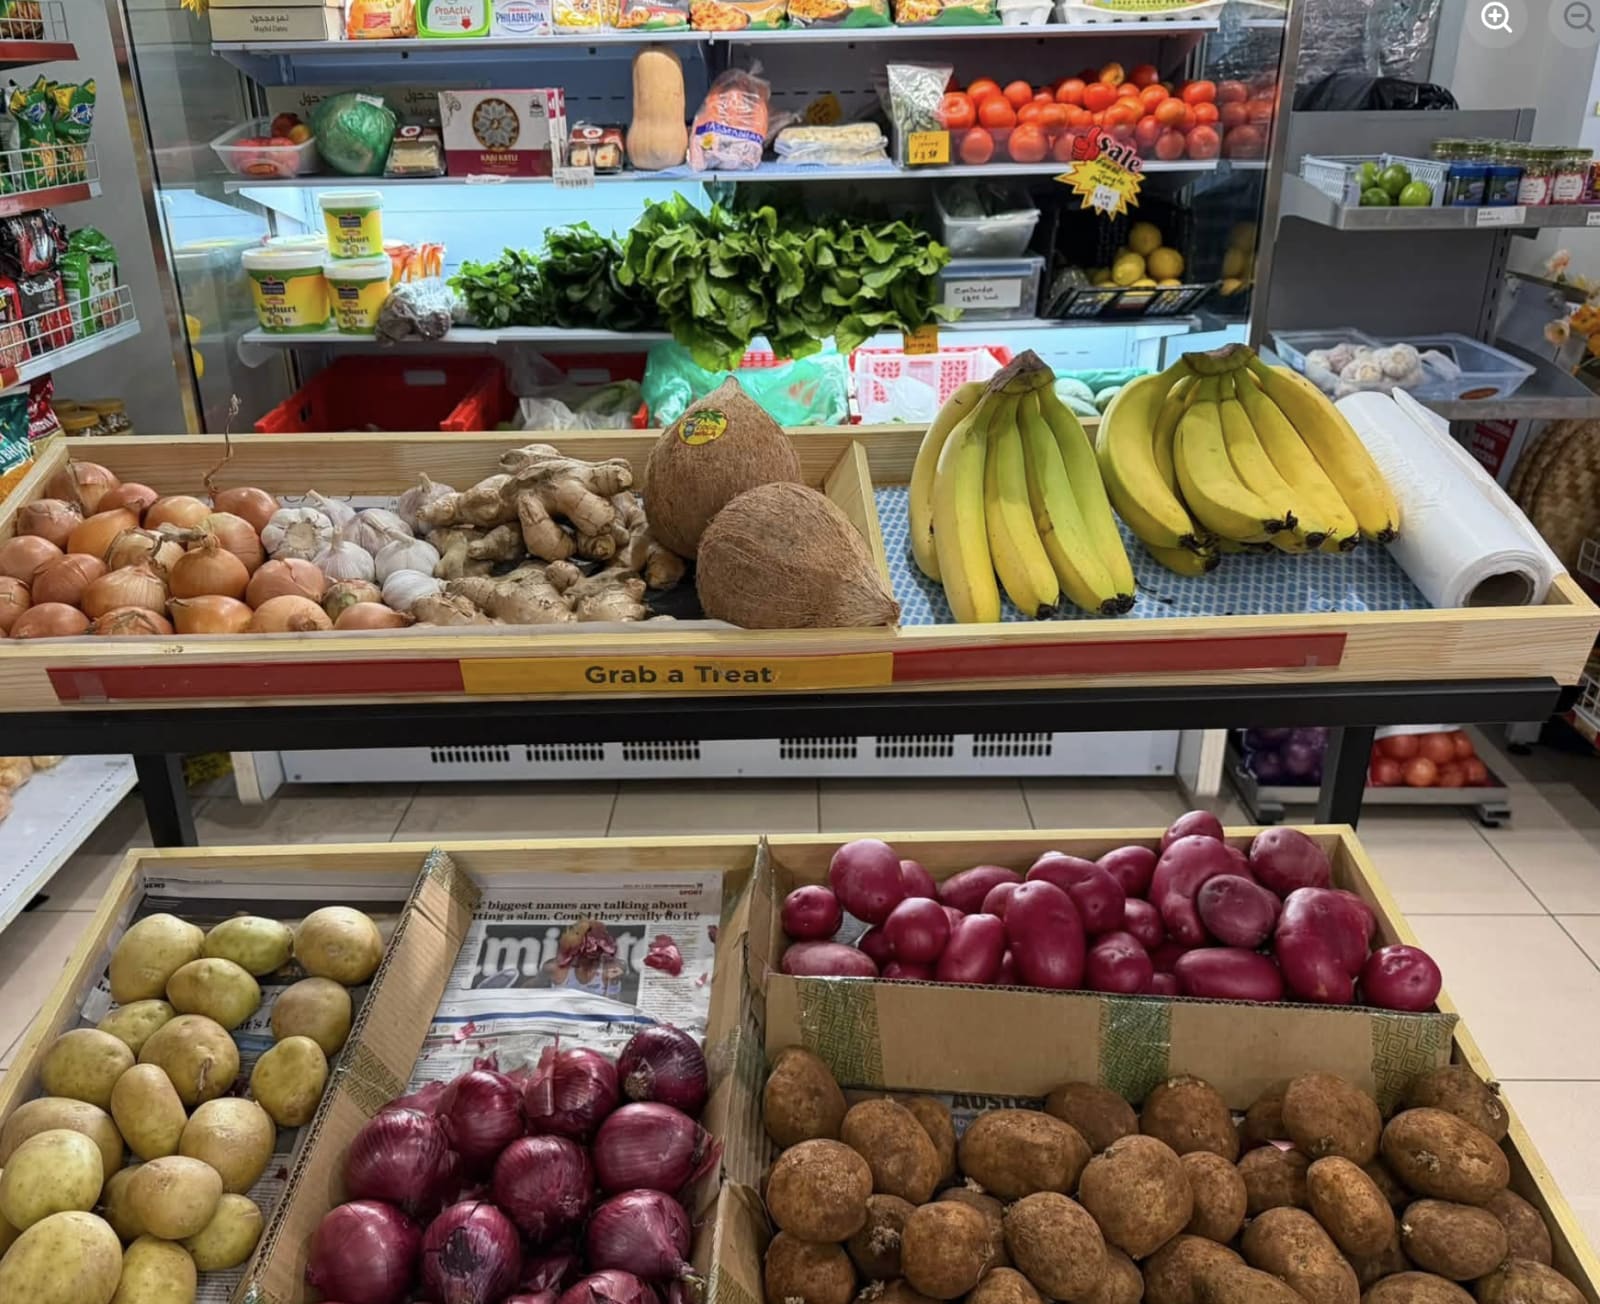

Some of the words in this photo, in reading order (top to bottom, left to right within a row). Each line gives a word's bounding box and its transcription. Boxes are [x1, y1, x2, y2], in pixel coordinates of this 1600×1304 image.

[495, 11, 545, 24] PHILADELPHIA
[584, 665, 657, 684] Grab
[668, 669, 685, 684] a
[694, 666, 772, 684] Treat
[488, 901, 533, 912] biggest
[536, 902, 578, 910] names
[580, 902, 601, 910] are
[603, 901, 649, 912] talking
[652, 901, 688, 910] about
[506, 913, 514, 921] a
[516, 911, 550, 921] slam.
[595, 911, 623, 923] they
[625, 911, 661, 923] really
[683, 911, 700, 921] it?
